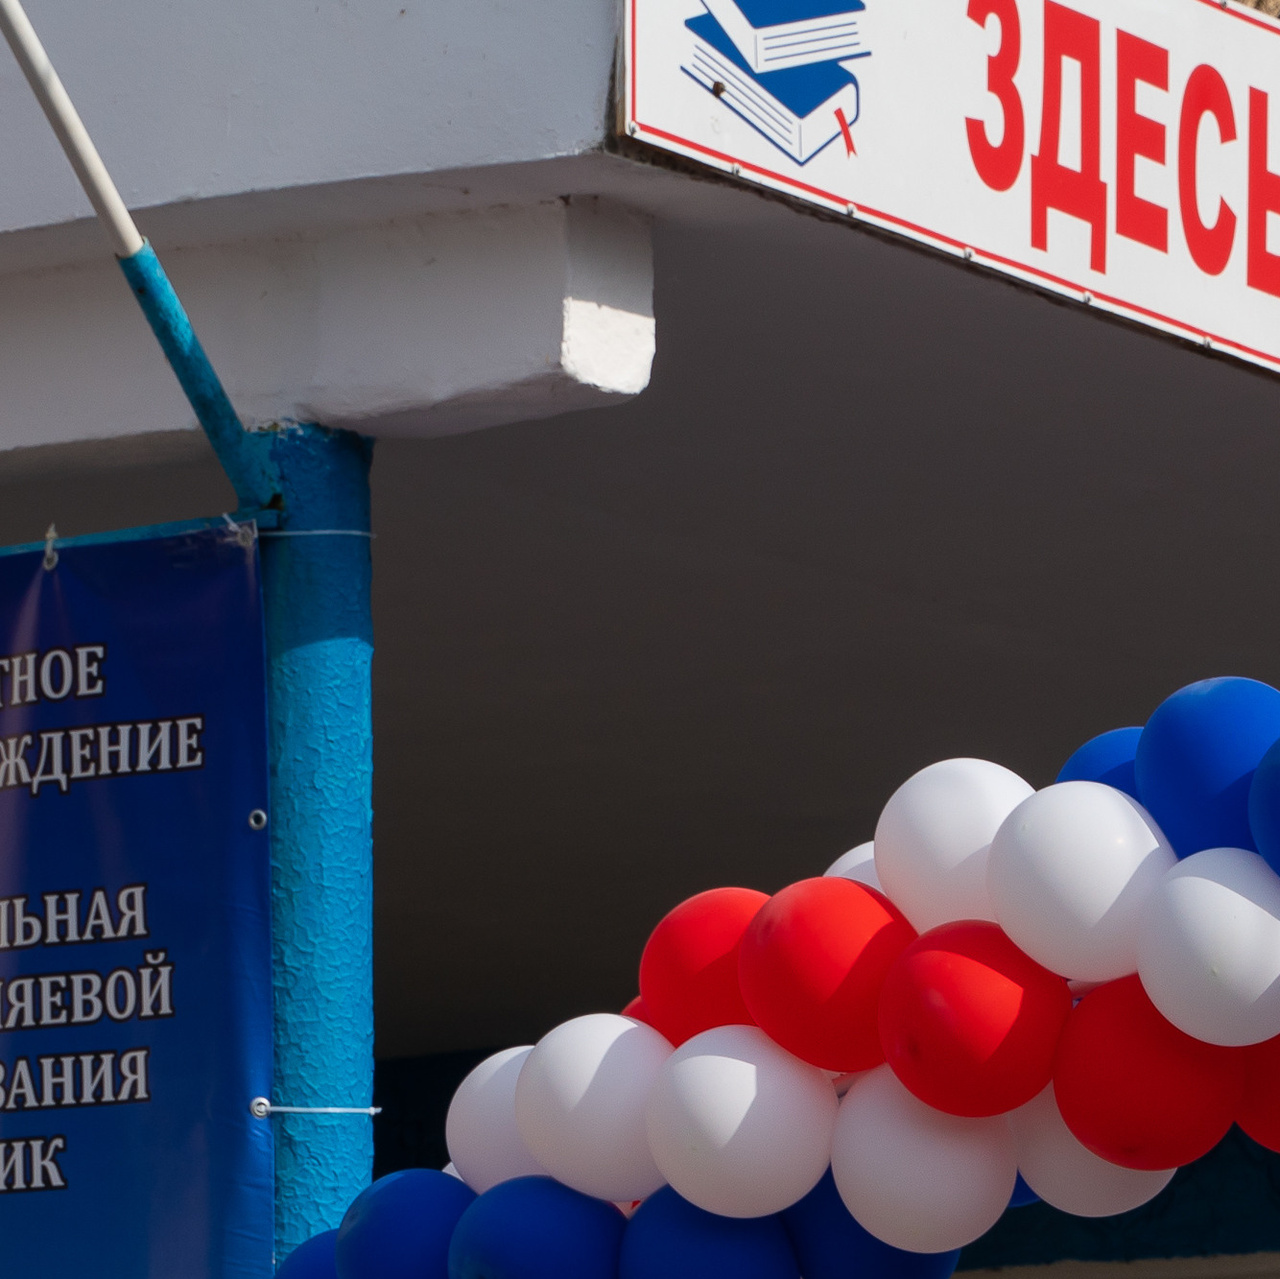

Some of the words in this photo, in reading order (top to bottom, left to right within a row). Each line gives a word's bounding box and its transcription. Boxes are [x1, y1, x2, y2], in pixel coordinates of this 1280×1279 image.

[0, 718, 202, 794] ЖДЕНИЕ
[0, 886, 148, 948] ЬНАЯ
[0, 952, 172, 1029] ЯЕВОЙ
[0, 1050, 148, 1109] АНИЯ
[0, 1137, 65, 1190] ИК
